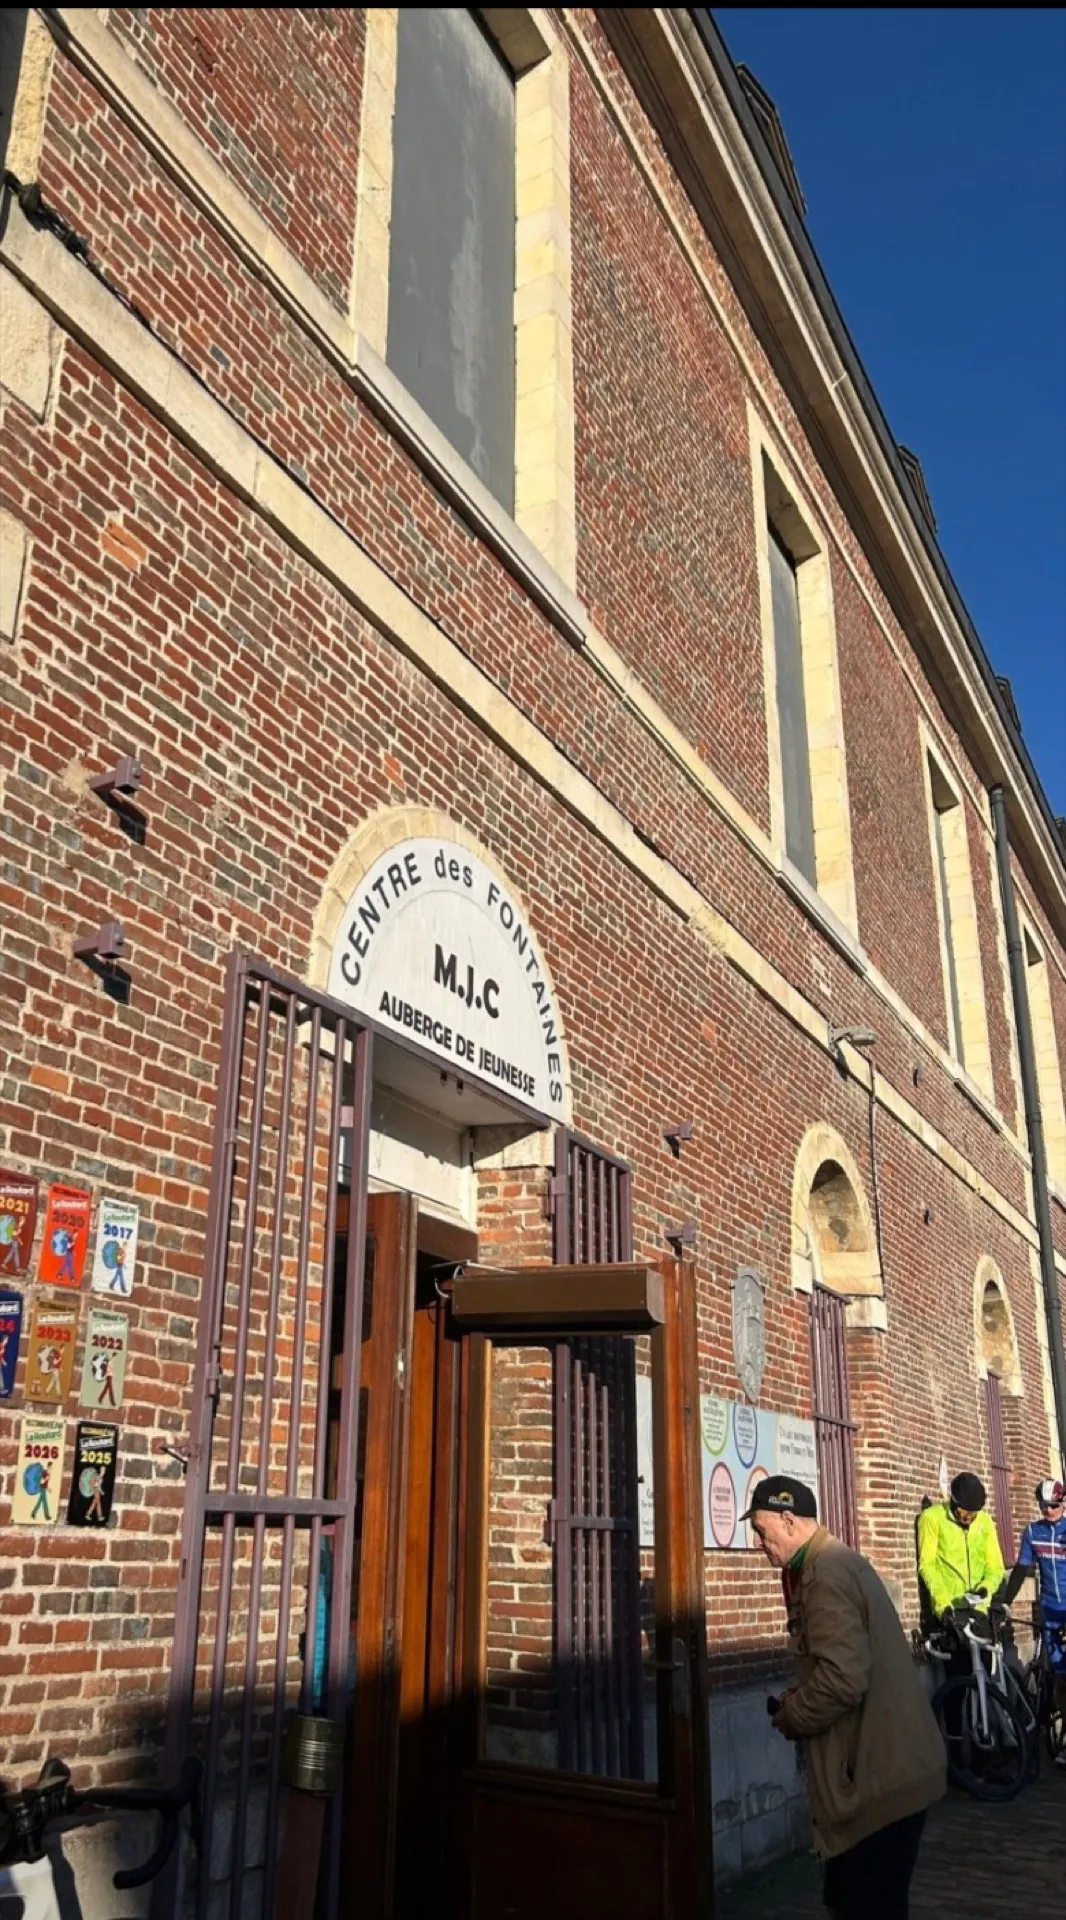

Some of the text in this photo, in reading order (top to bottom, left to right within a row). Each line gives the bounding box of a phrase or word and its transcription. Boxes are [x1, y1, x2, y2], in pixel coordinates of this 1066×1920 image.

[341, 849, 563, 1103] CENTRE des FONTAINES
[433, 943, 500, 1019] M.J.C
[379, 990, 535, 1098] AUBERGE DE JEUNESSE
[0, 1195, 30, 1214] 2021
[51, 1209, 86, 1228] 2020
[103, 1222, 134, 1240] 2017
[0, 1318, 15, 1332] 24
[36, 1325, 72, 1342] 2023
[91, 1334, 124, 1350] 2022
[25, 1443, 59, 1459] 2026
[80, 1450, 112, 1465] 2025
